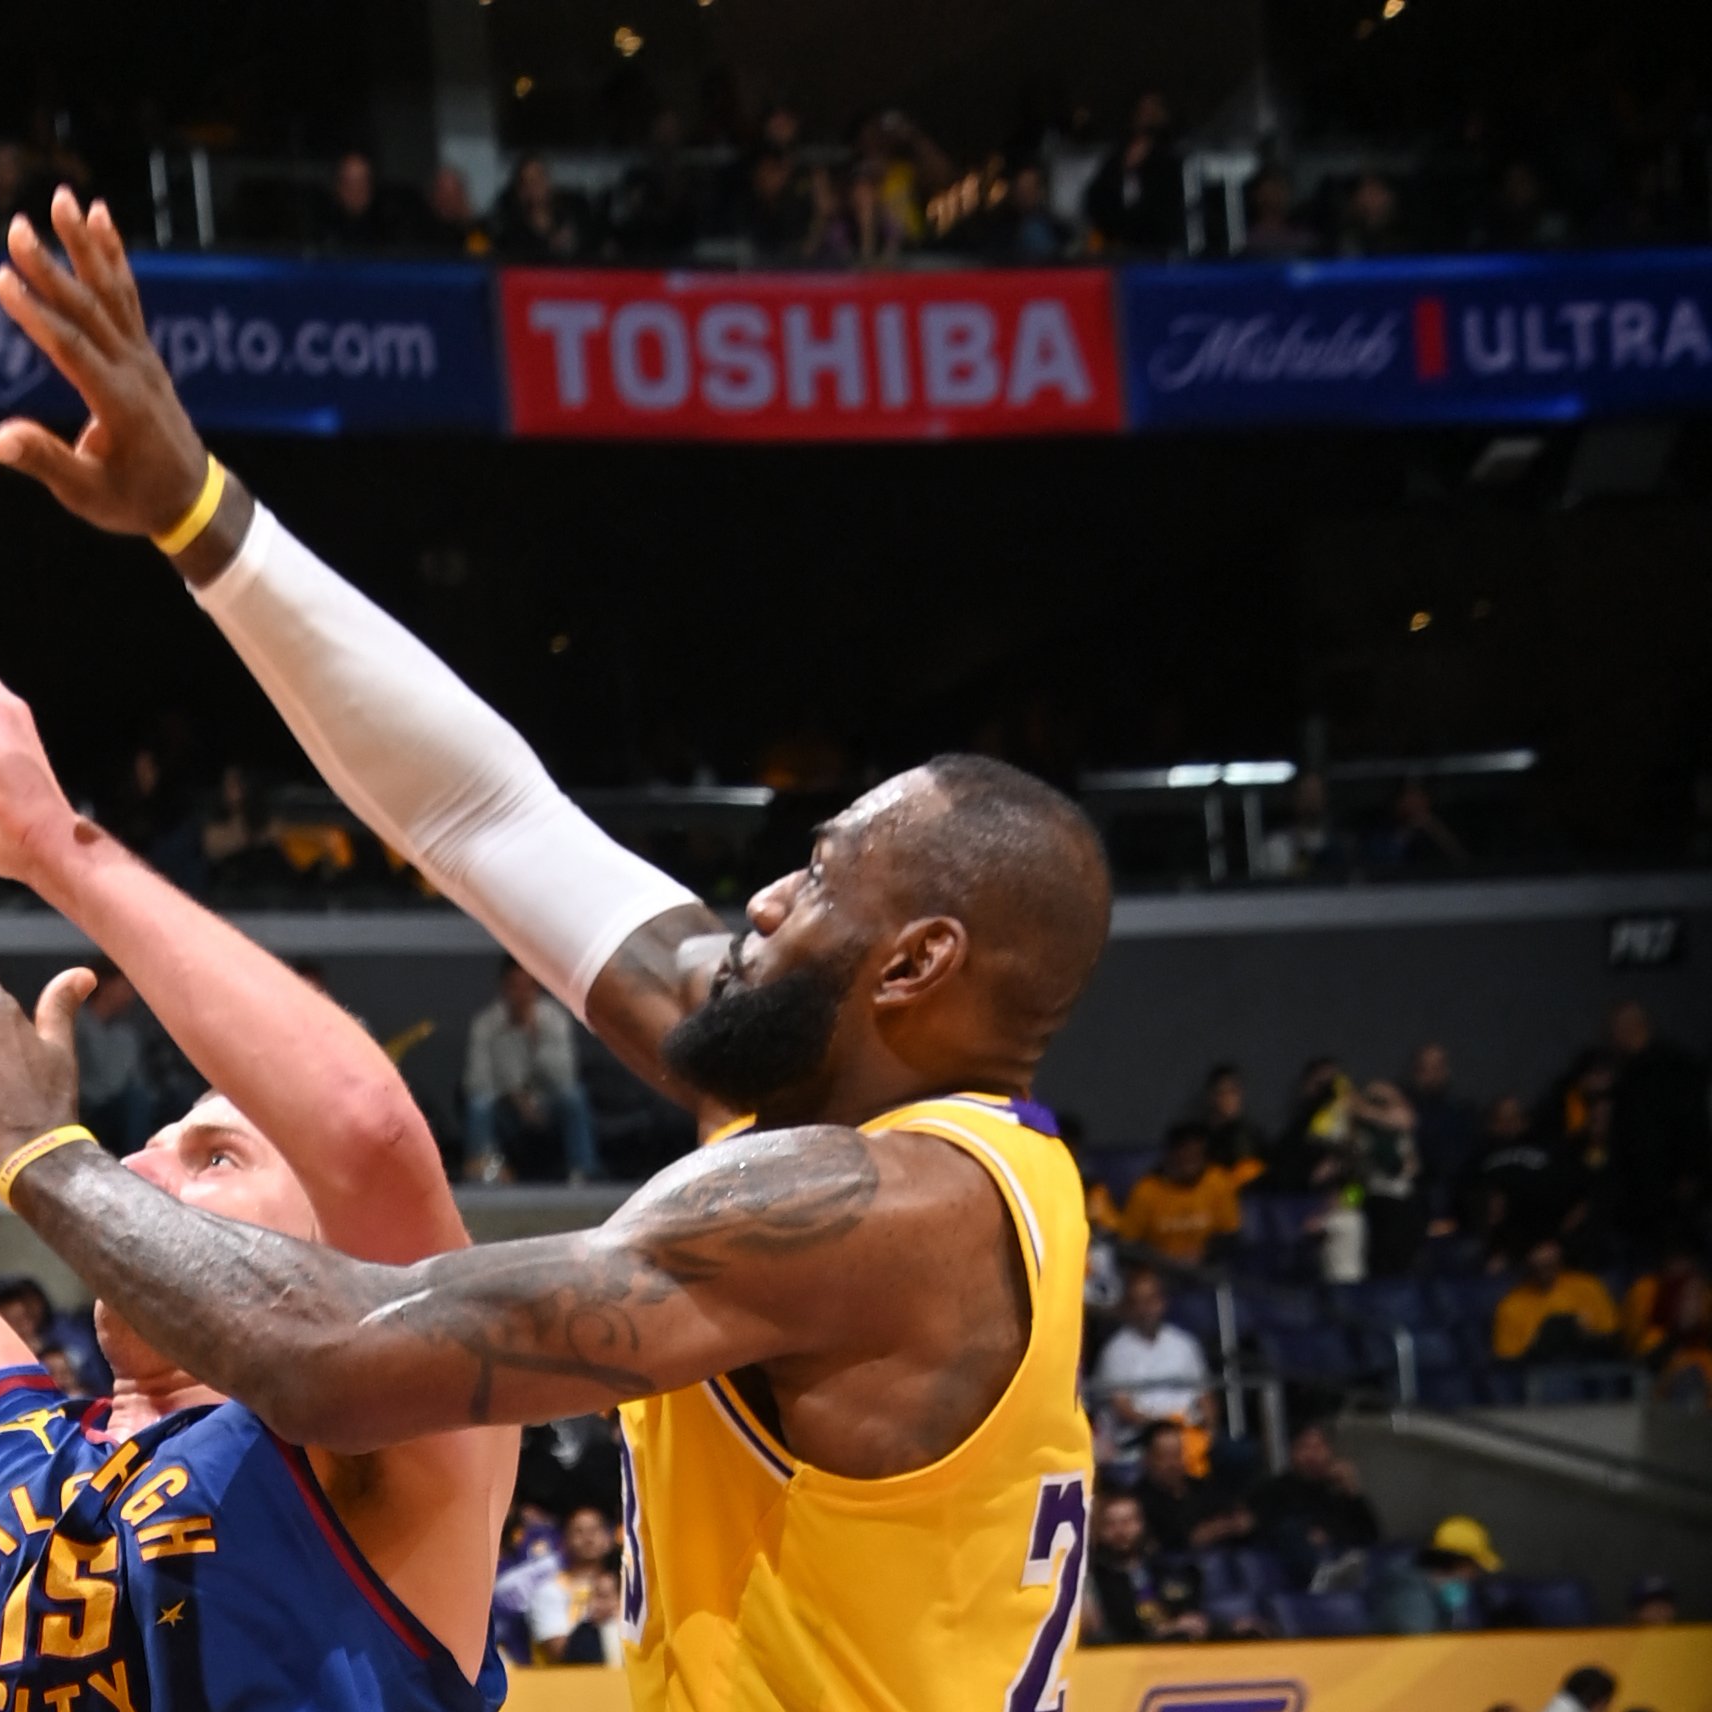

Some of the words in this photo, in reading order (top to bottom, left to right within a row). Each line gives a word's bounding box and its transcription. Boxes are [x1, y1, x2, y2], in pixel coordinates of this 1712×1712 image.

[150, 306, 438, 383] pto.com
[527, 299, 1093, 413] TOSHIBA
[1461, 298, 1712, 375] ULTRA
